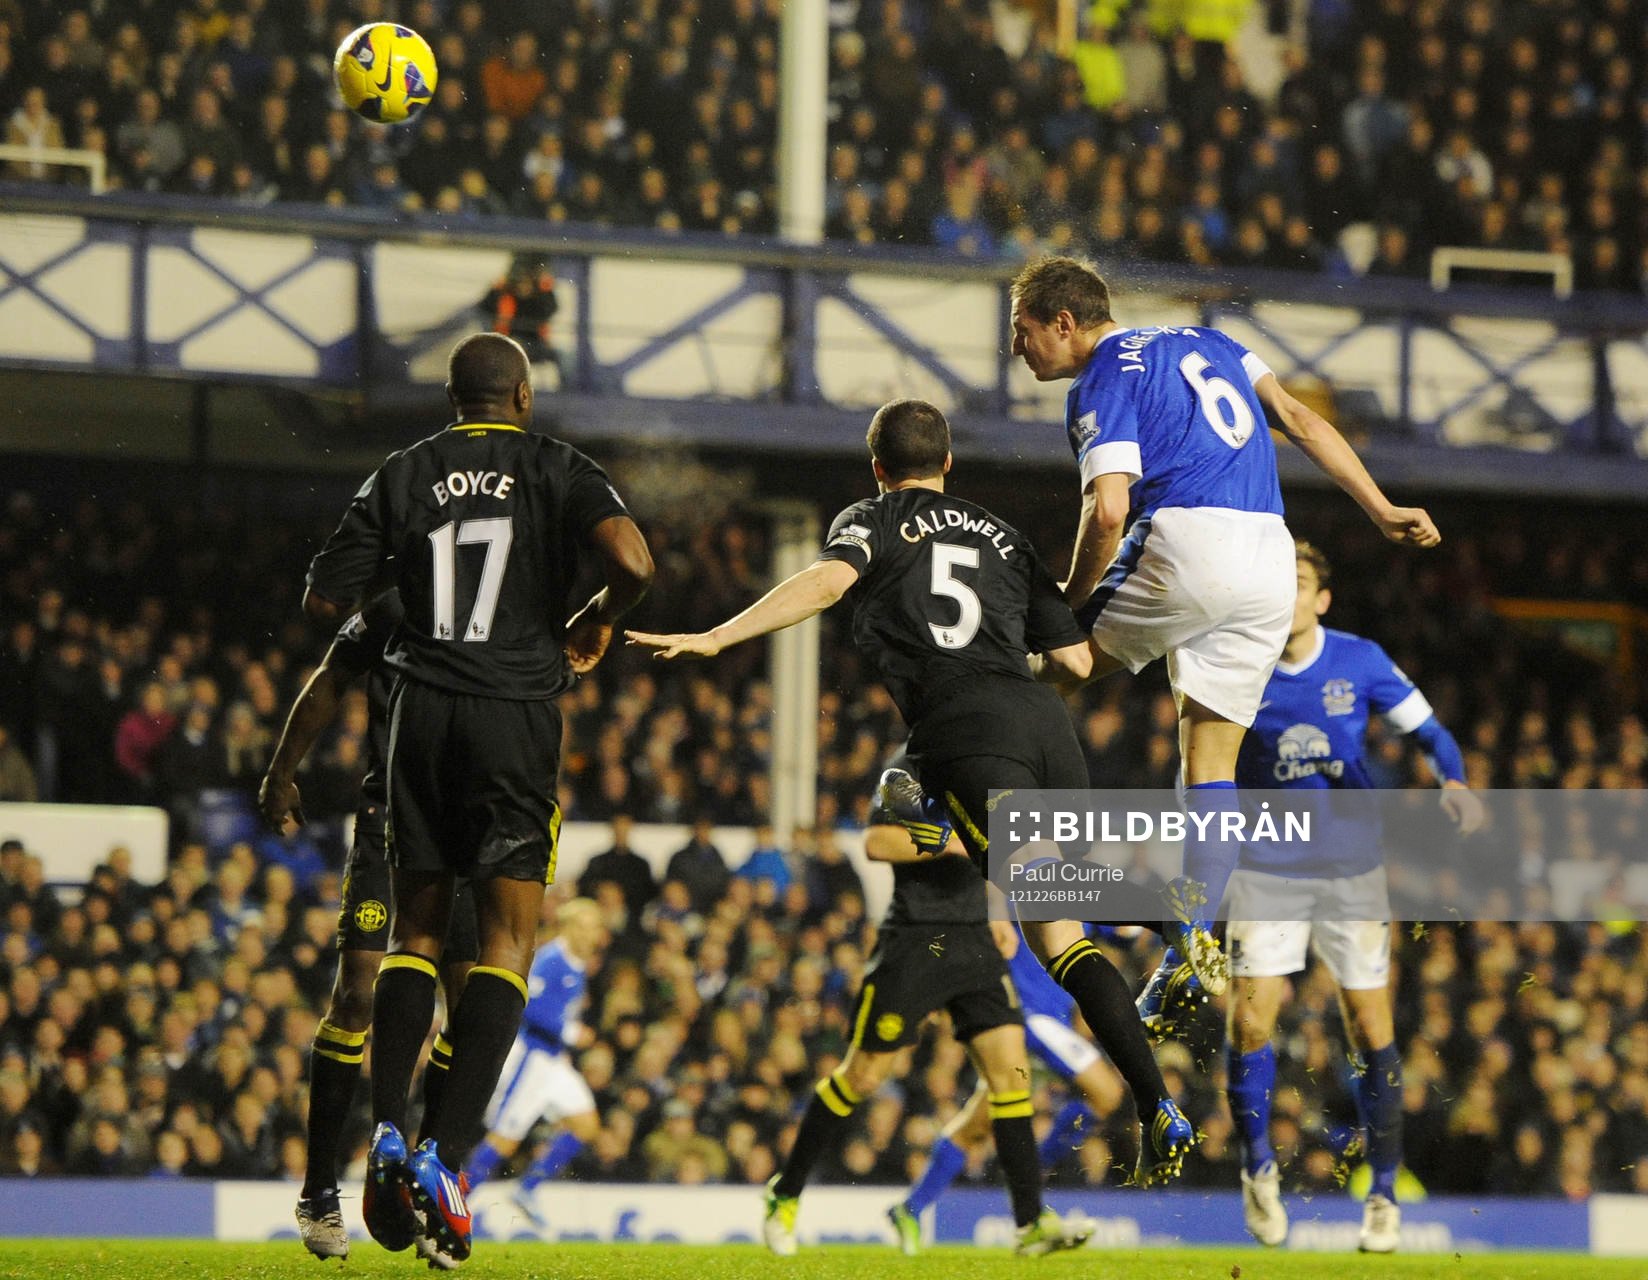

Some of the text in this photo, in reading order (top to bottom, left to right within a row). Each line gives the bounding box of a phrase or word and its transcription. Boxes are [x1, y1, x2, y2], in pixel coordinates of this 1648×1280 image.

[1179, 350, 1255, 450] 6
[431, 470, 515, 507] BOYCE
[900, 509, 1014, 560] CALDWELL
[427, 516, 513, 642] 17
[928, 541, 982, 649] 5
[1273, 758, 1345, 782] Chang
